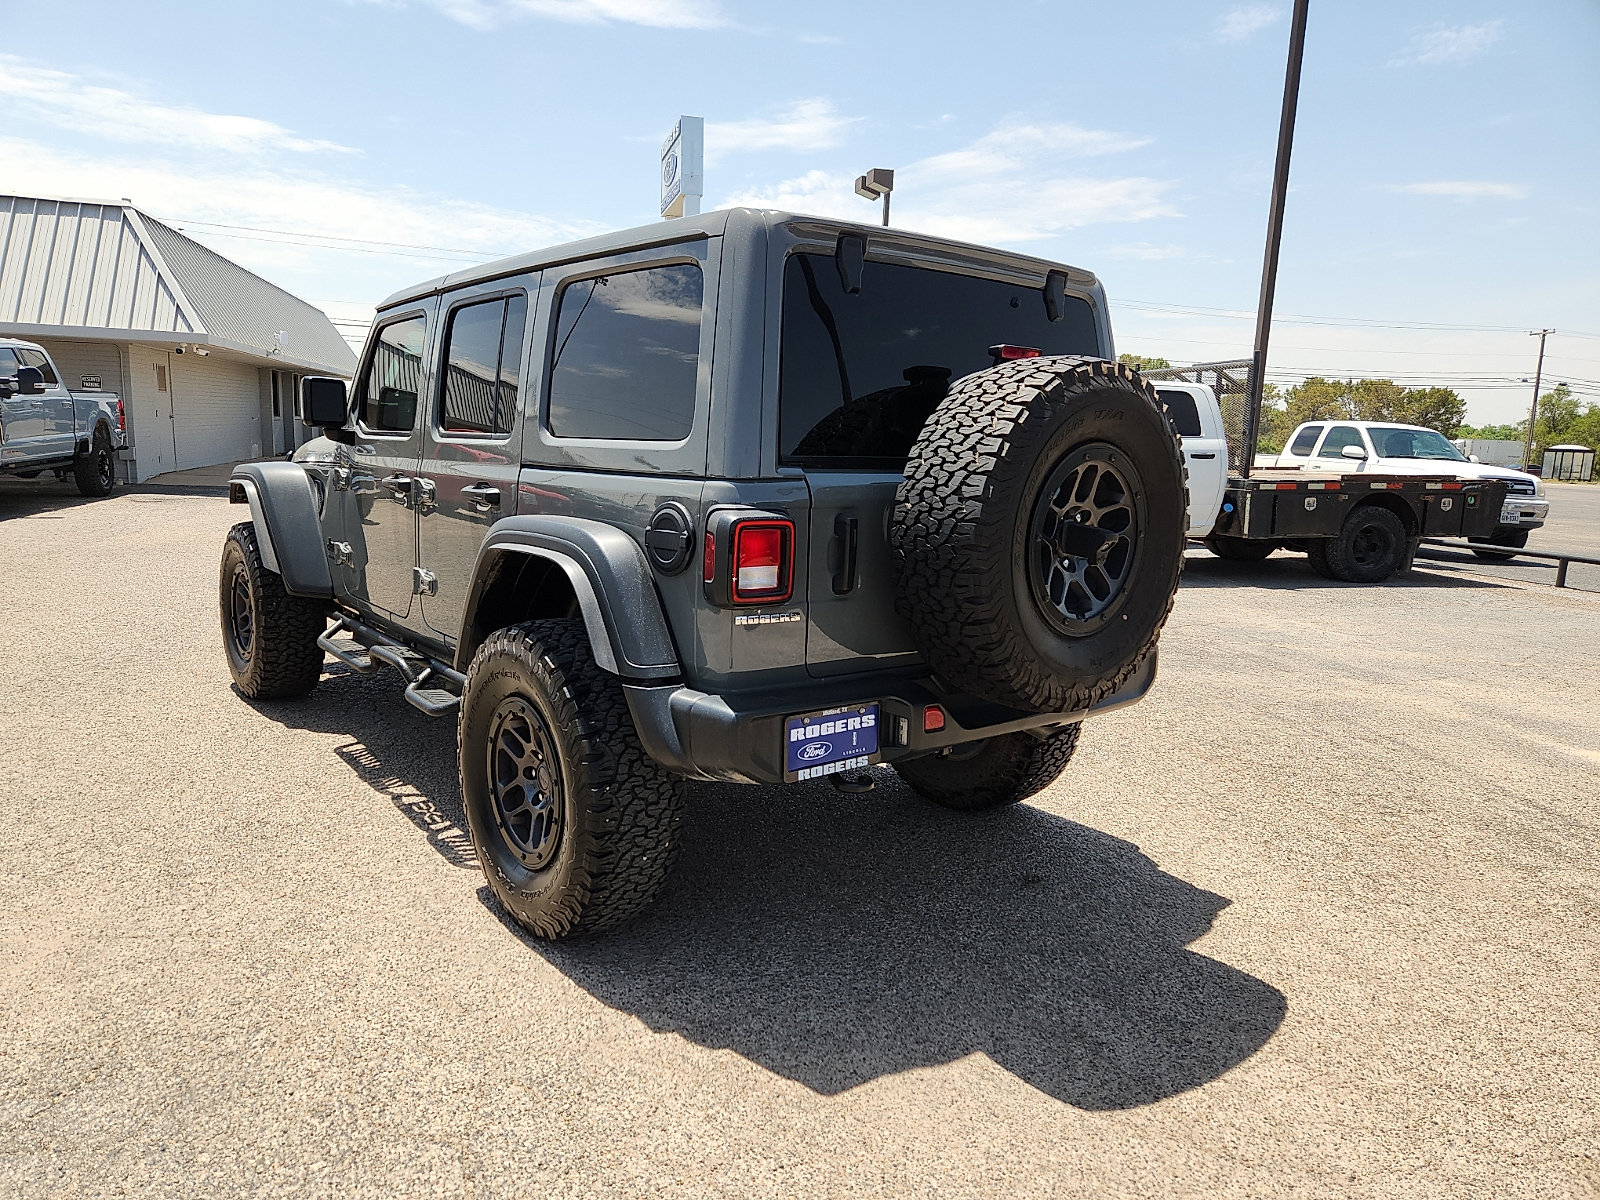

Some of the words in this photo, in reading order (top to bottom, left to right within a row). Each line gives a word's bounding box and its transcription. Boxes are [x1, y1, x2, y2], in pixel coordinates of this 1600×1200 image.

[734, 612, 801, 626] ROGERS
[790, 714, 875, 742] ROGERS
[803, 743, 827, 758] Ford
[842, 747, 866, 756] LINCOLN
[798, 755, 869, 781] ROGERS
